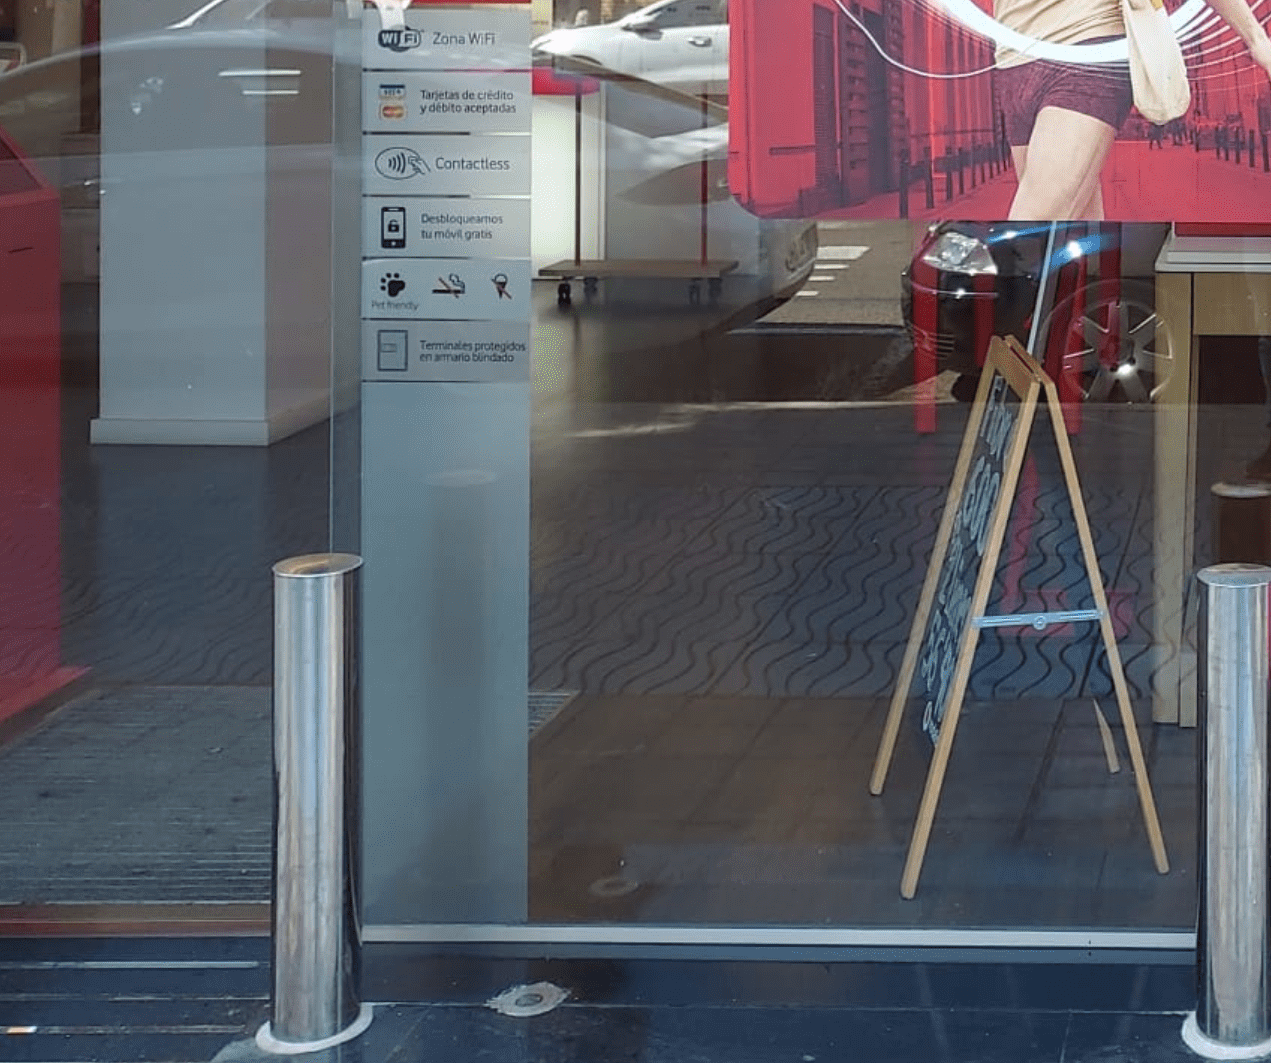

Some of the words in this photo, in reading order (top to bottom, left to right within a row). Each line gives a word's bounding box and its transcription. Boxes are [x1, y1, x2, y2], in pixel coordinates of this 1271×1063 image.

[432, 32, 466, 45] Zona
[468, 32, 496, 45] WiFi
[420, 89, 460, 102] Tarjetas
[461, 89, 475, 100] de
[477, 89, 514, 100] crédito
[419, 104, 427, 115] y
[428, 102, 462, 113] débito
[464, 103, 517, 115] aceptadas
[435, 156, 511, 171] Contactless
[420, 213, 504, 225] Desbloqueamos
[421, 230, 433, 240] tu
[434, 228, 463, 240] móvil
[464, 229, 493, 241] gratis
[371, 300, 384, 309] Pet
[385, 300, 420, 311] friendly
[419, 339, 473, 351] Terminales
[474, 340, 527, 354] protegidos
[419, 353, 433, 362] en
[434, 352, 470, 362] armario
[472, 351, 515, 363] blindado
